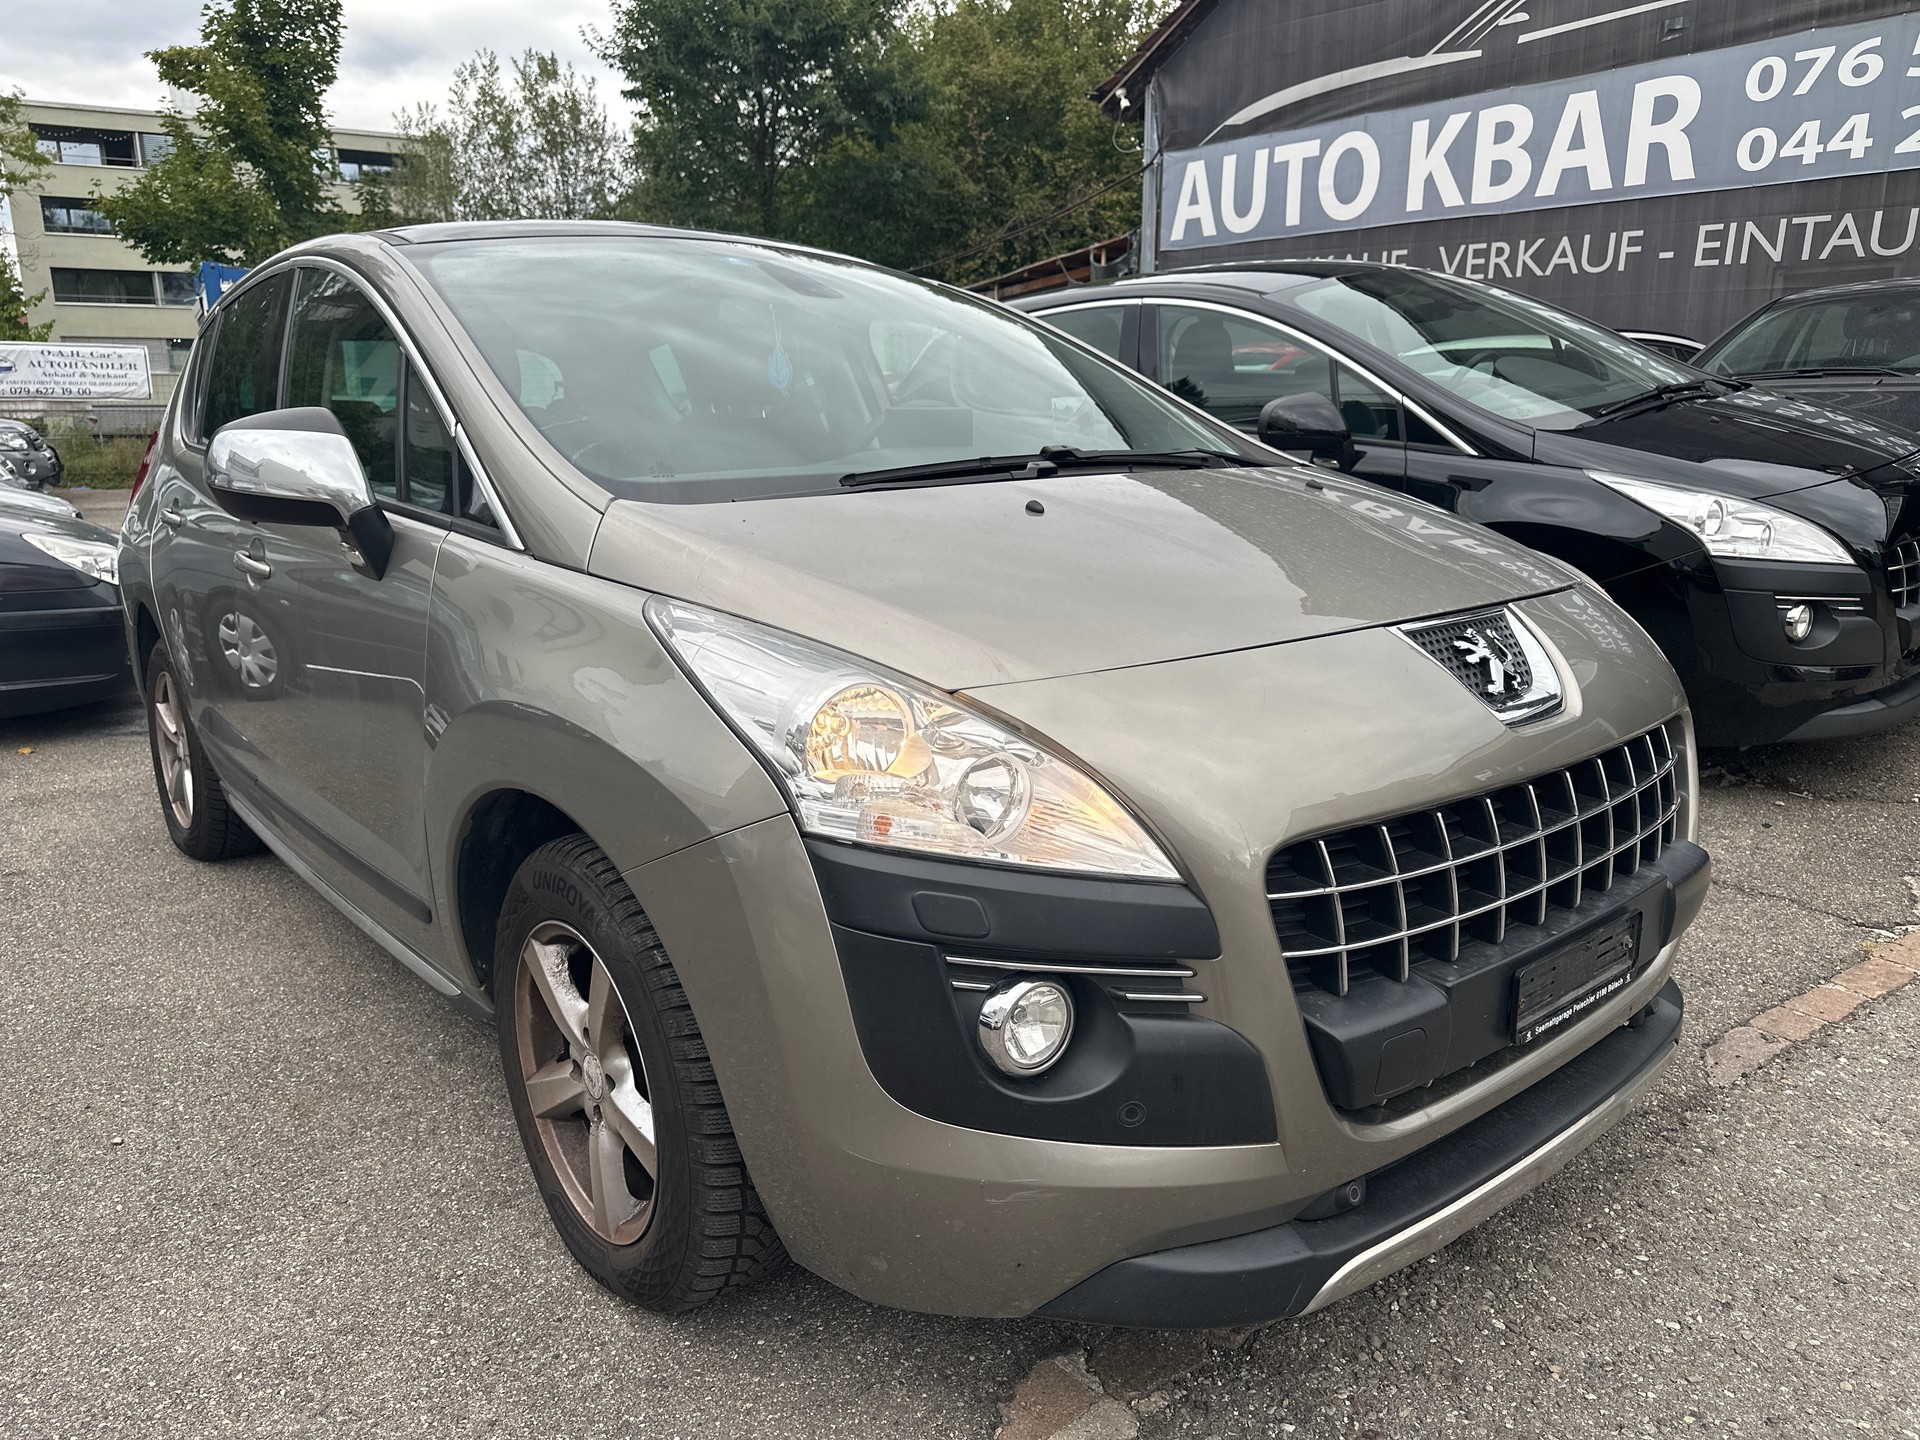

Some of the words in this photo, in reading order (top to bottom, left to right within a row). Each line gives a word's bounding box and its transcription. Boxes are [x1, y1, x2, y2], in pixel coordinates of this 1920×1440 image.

[1745, 36, 1884, 102] 076
[1170, 131, 1380, 241] AUTO
[1406, 75, 1701, 212] KBAR
[1736, 113, 1873, 171] 044
[1439, 230, 1645, 280] VERKAUF
[1694, 207, 1920, 267] EINTAU
[10, 386, 31, 396] 079
[35, 386, 55, 396] 627
[61, 387, 73, 396] 19
[77, 387, 91, 396] 00
